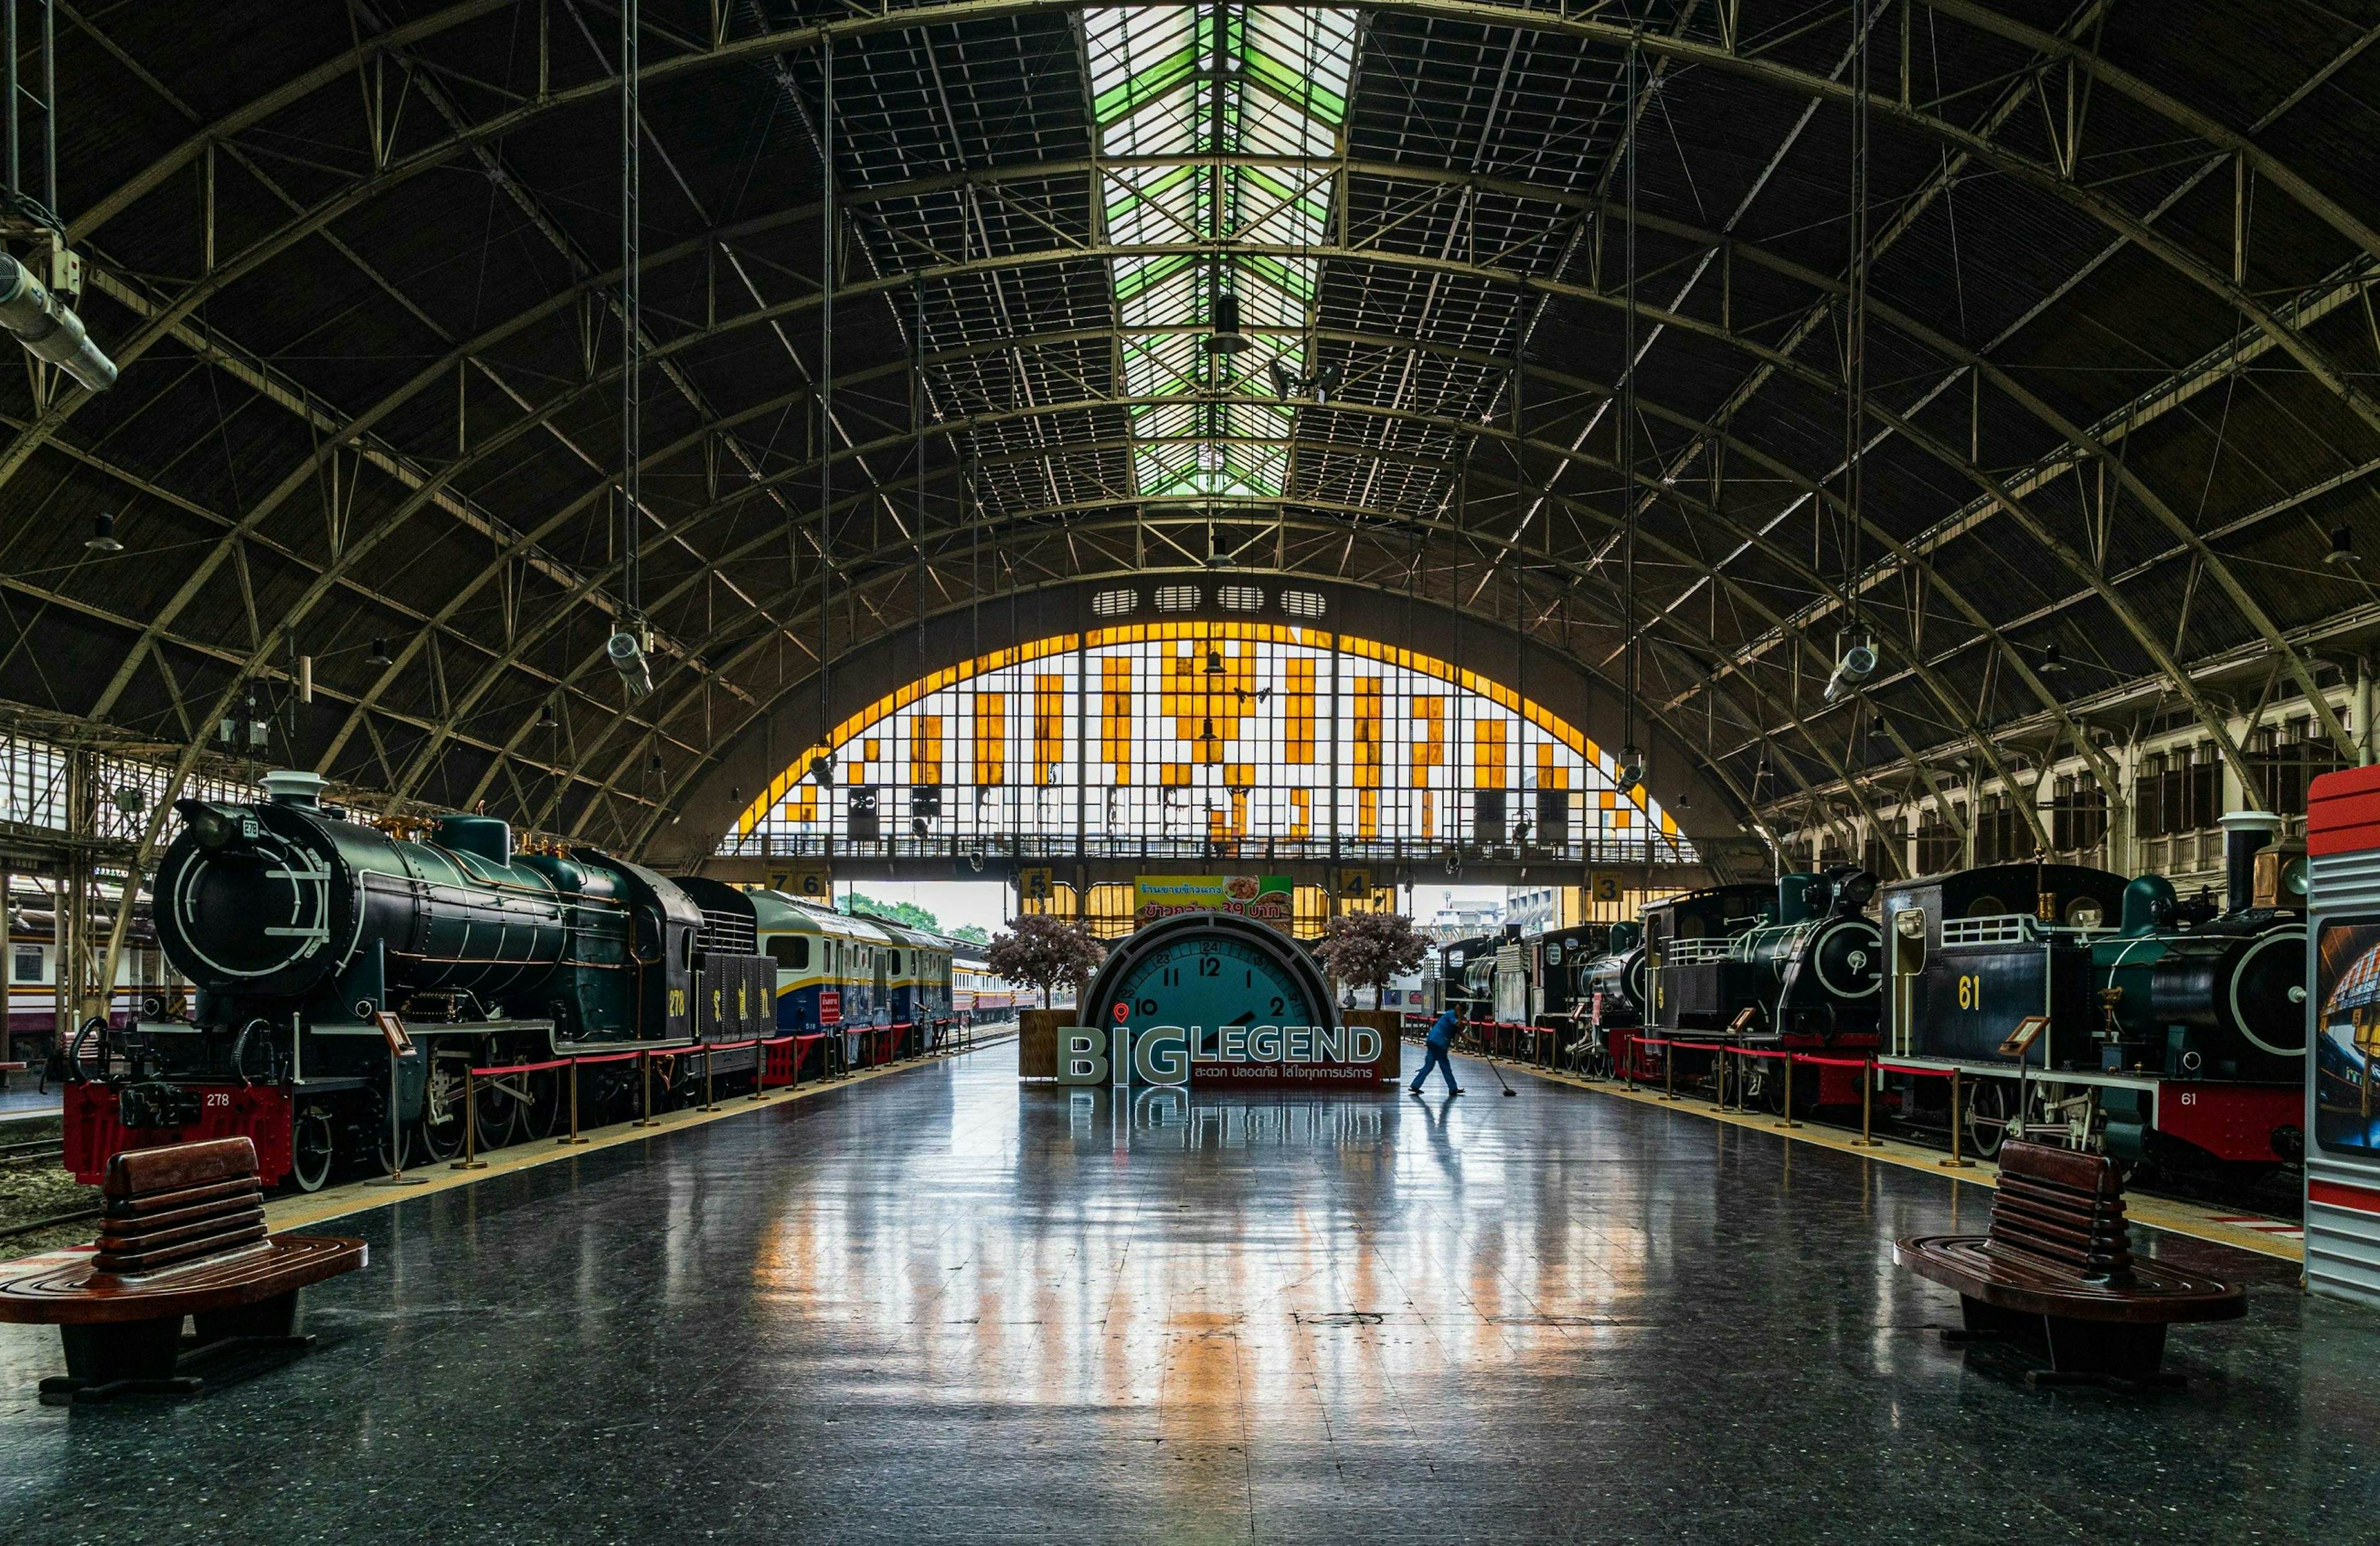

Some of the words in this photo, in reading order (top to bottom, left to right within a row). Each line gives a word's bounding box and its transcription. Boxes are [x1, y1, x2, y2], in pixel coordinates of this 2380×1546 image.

[245, 823, 257, 834] 278
[772, 874, 787, 890] 7
[804, 875, 819, 893] 6
[1031, 874, 1046, 896] 5
[1141, 883, 1222, 894] ร้านขายข้าวแกง
[1347, 876, 1364, 895] 4
[1600, 880, 1616, 899] 3
[1222, 903, 1245, 916] 39
[1249, 904, 1280, 917] บาท
[1202, 942, 1218, 952] 24
[1157, 955, 1170, 965] 23
[1200, 957, 1220, 976] 12
[1163, 968, 1178, 986] 11
[1246, 970, 1251, 988] 1
[1958, 974, 1980, 1011] 61
[669, 989, 684, 1017] 278
[1135, 997, 1158, 1016] 10
[1270, 997, 1284, 1017] 2
[1057, 1026, 1188, 1085] BIG
[1191, 1025, 1382, 1062] LEGEND
[1194, 1067, 1228, 1077] สะดวก
[1232, 1066, 1277, 1077] ปลอดภัย
[1282, 1064, 1372, 1080] ใส่ใจทุกการบริการ
[207, 1093, 229, 1106] 278
[2180, 1093, 2197, 1106] 61
